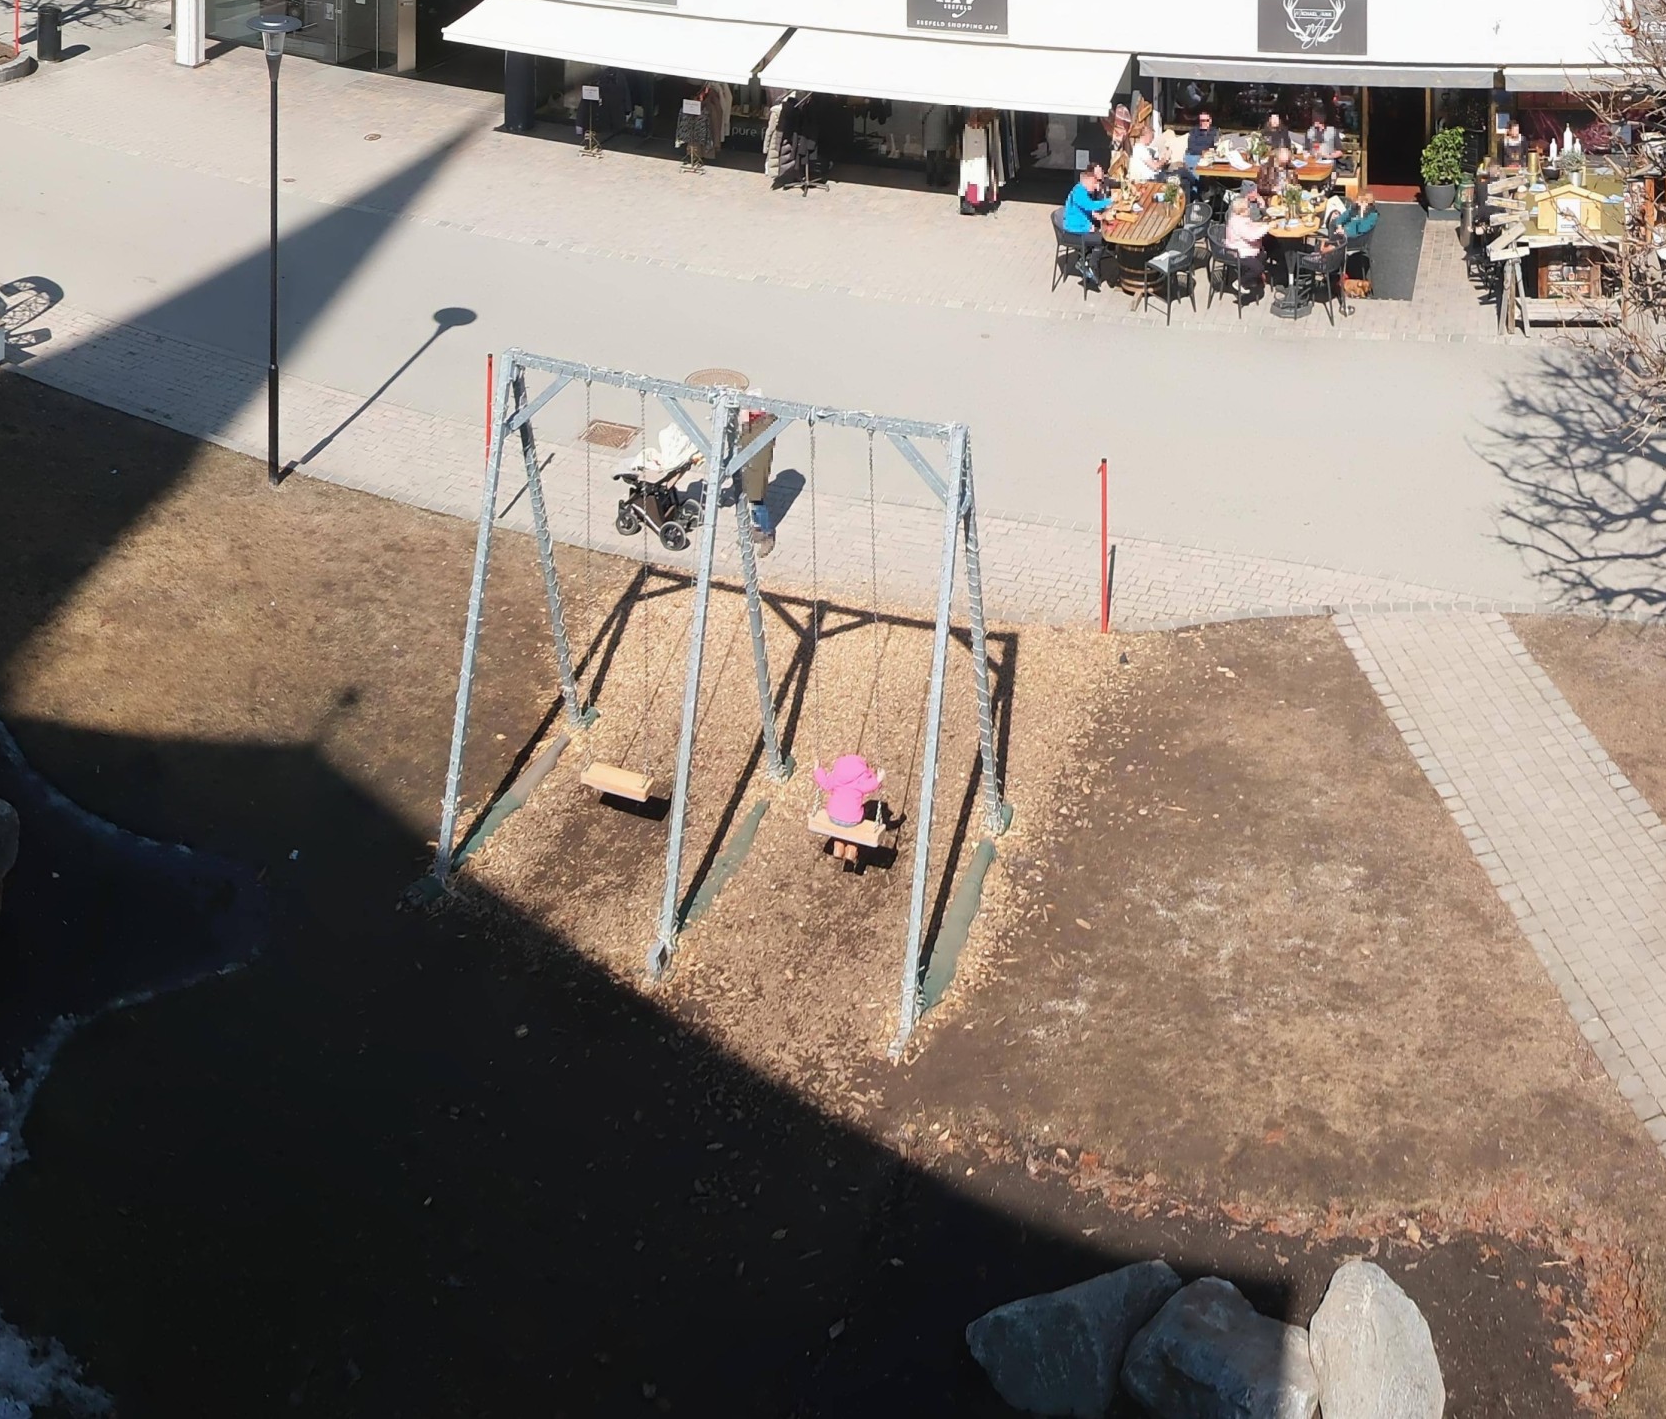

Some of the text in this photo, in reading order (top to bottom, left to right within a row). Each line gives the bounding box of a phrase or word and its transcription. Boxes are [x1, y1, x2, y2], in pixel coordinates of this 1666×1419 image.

[944, 3, 973, 11] SEEFELD
[916, 19, 946, 27] SEEFELD
[948, 21, 983, 30] SHOPPING
